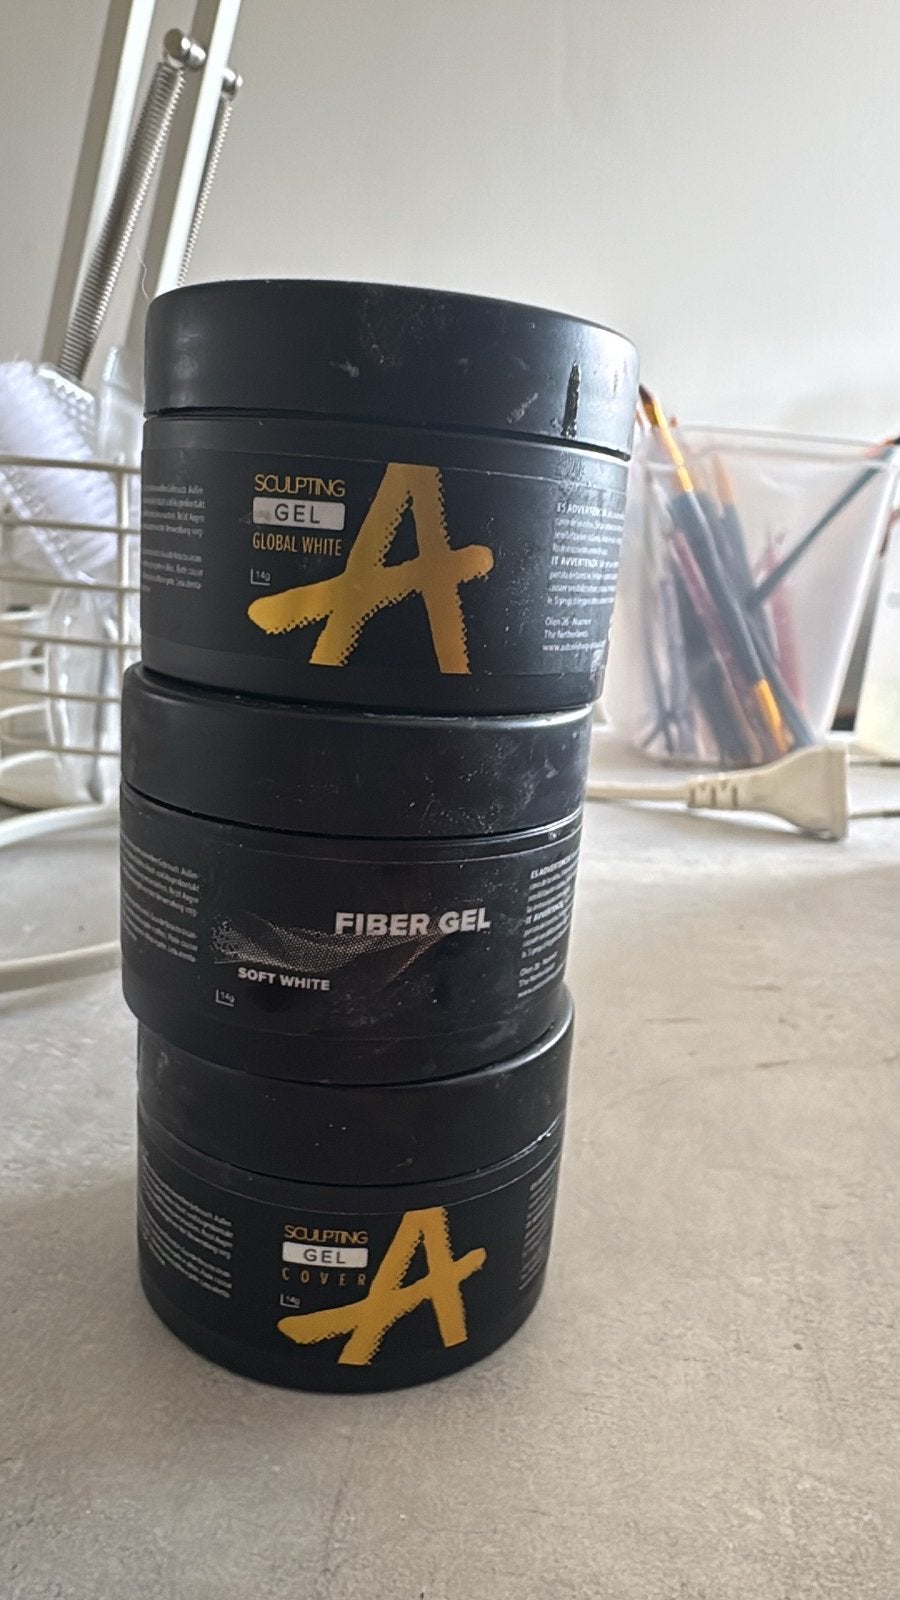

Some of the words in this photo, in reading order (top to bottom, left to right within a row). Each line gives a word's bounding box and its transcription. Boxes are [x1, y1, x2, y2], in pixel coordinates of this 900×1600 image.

[253, 473, 346, 498] SCULPTING
[274, 502, 321, 525] GEL
[252, 532, 298, 553] GLOBAL
[302, 535, 343, 557] WHITE
[255, 570, 271, 583] 14g
[333, 911, 431, 937] FIBER
[438, 906, 491, 935] GEL
[236, 966, 276, 985] SOFT
[279, 973, 331, 992] WHITE
[284, 1224, 369, 1245] SCULPTING
[303, 1248, 347, 1265] GEL
